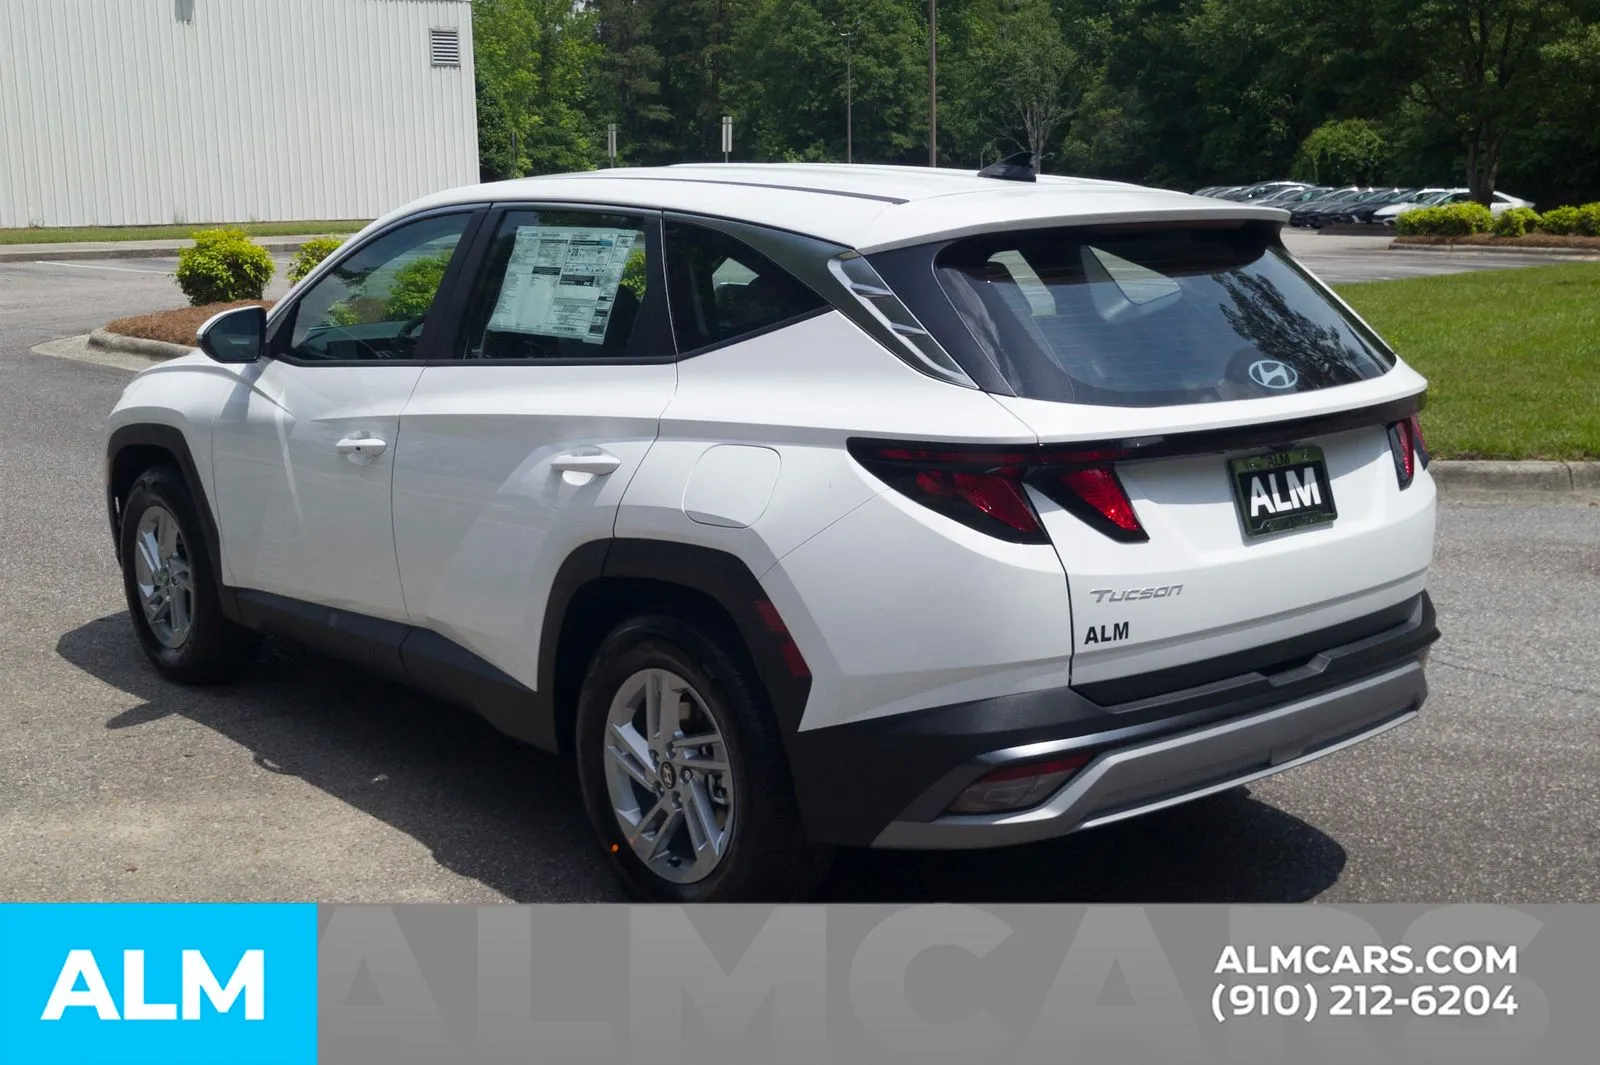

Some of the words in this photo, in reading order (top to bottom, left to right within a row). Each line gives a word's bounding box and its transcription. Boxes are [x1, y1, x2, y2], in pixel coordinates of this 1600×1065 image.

[1267, 452, 1291, 467] ALM
[1250, 467, 1322, 517] ALM
[1084, 621, 1129, 645] ALM
